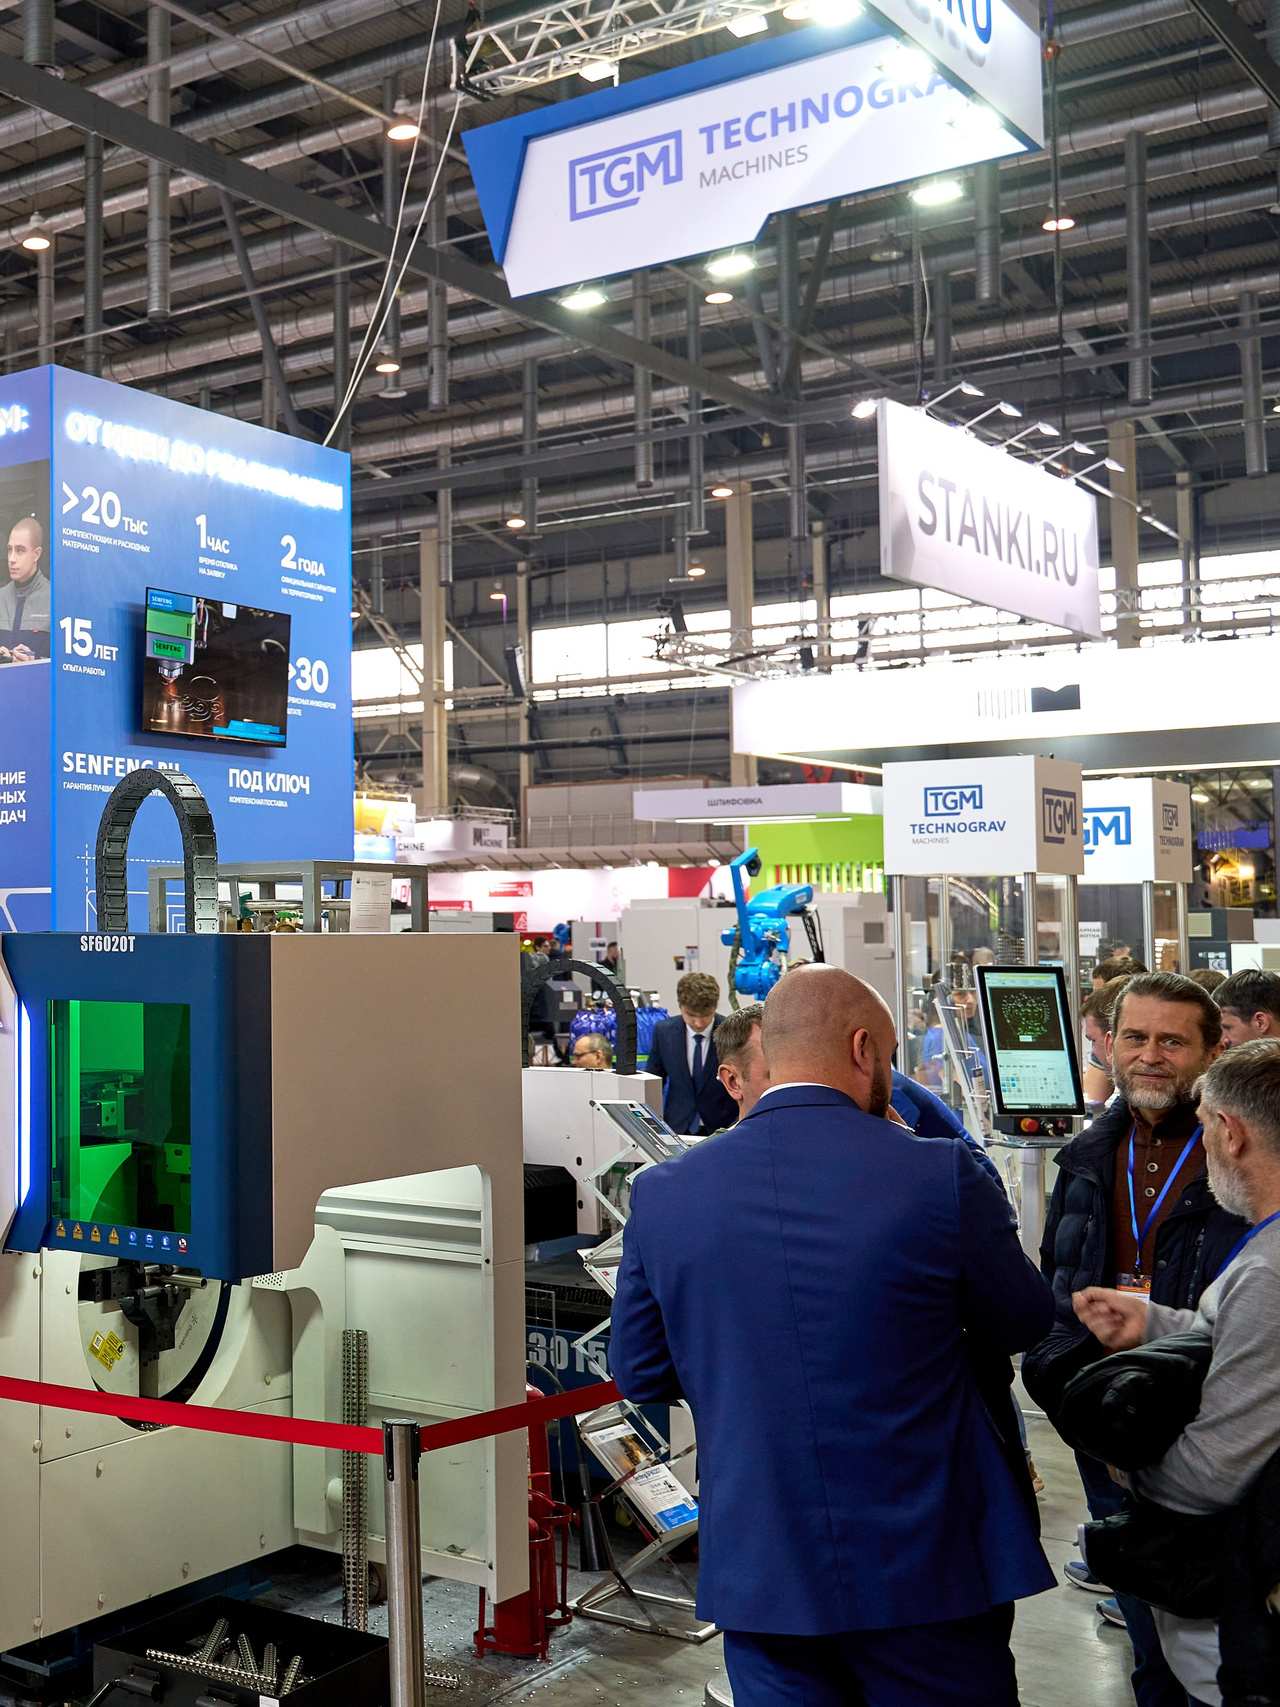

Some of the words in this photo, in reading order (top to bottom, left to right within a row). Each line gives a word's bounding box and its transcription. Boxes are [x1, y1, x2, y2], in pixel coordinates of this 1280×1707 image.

[577, 141, 683, 207] TGM
[699, 144, 809, 189] MACHINES
[65, 411, 102, 445] ОТ
[62, 527, 112, 545] КОМПЛЕКТУЮЩИХ
[122, 516, 149, 536] ТЫС
[195, 514, 207, 549] 1
[206, 535, 231, 554] ЧАС
[918, 469, 1078, 587] STANKI.RU
[62, 538, 100, 554] МАТЕРИАЛОВ
[280, 534, 297, 570] 2
[298, 557, 326, 577] ГОДА
[59, 616, 93, 657] 15
[93, 644, 119, 661] ЛЕТ
[155, 642, 181, 653] SENFENG
[62, 663, 82, 673] ОПЫТА
[82, 665, 106, 676] РАБОТЫ
[63, 781, 91, 792] ГАРАНТИЯ
[228, 768, 263, 793] ПОД
[265, 772, 310, 795] КЛЮЧ
[707, 797, 763, 807] ШЛИФОВКА
[927, 788, 983, 812] TGM
[1044, 797, 1078, 836] TGM
[1163, 807, 1179, 829] TGM
[909, 820, 1007, 835] TECHNOGRAV
[912, 836, 950, 845] MACHINES
[1159, 835, 1185, 847] TECHNOGRAV
[80, 935, 136, 952] SF6020T
